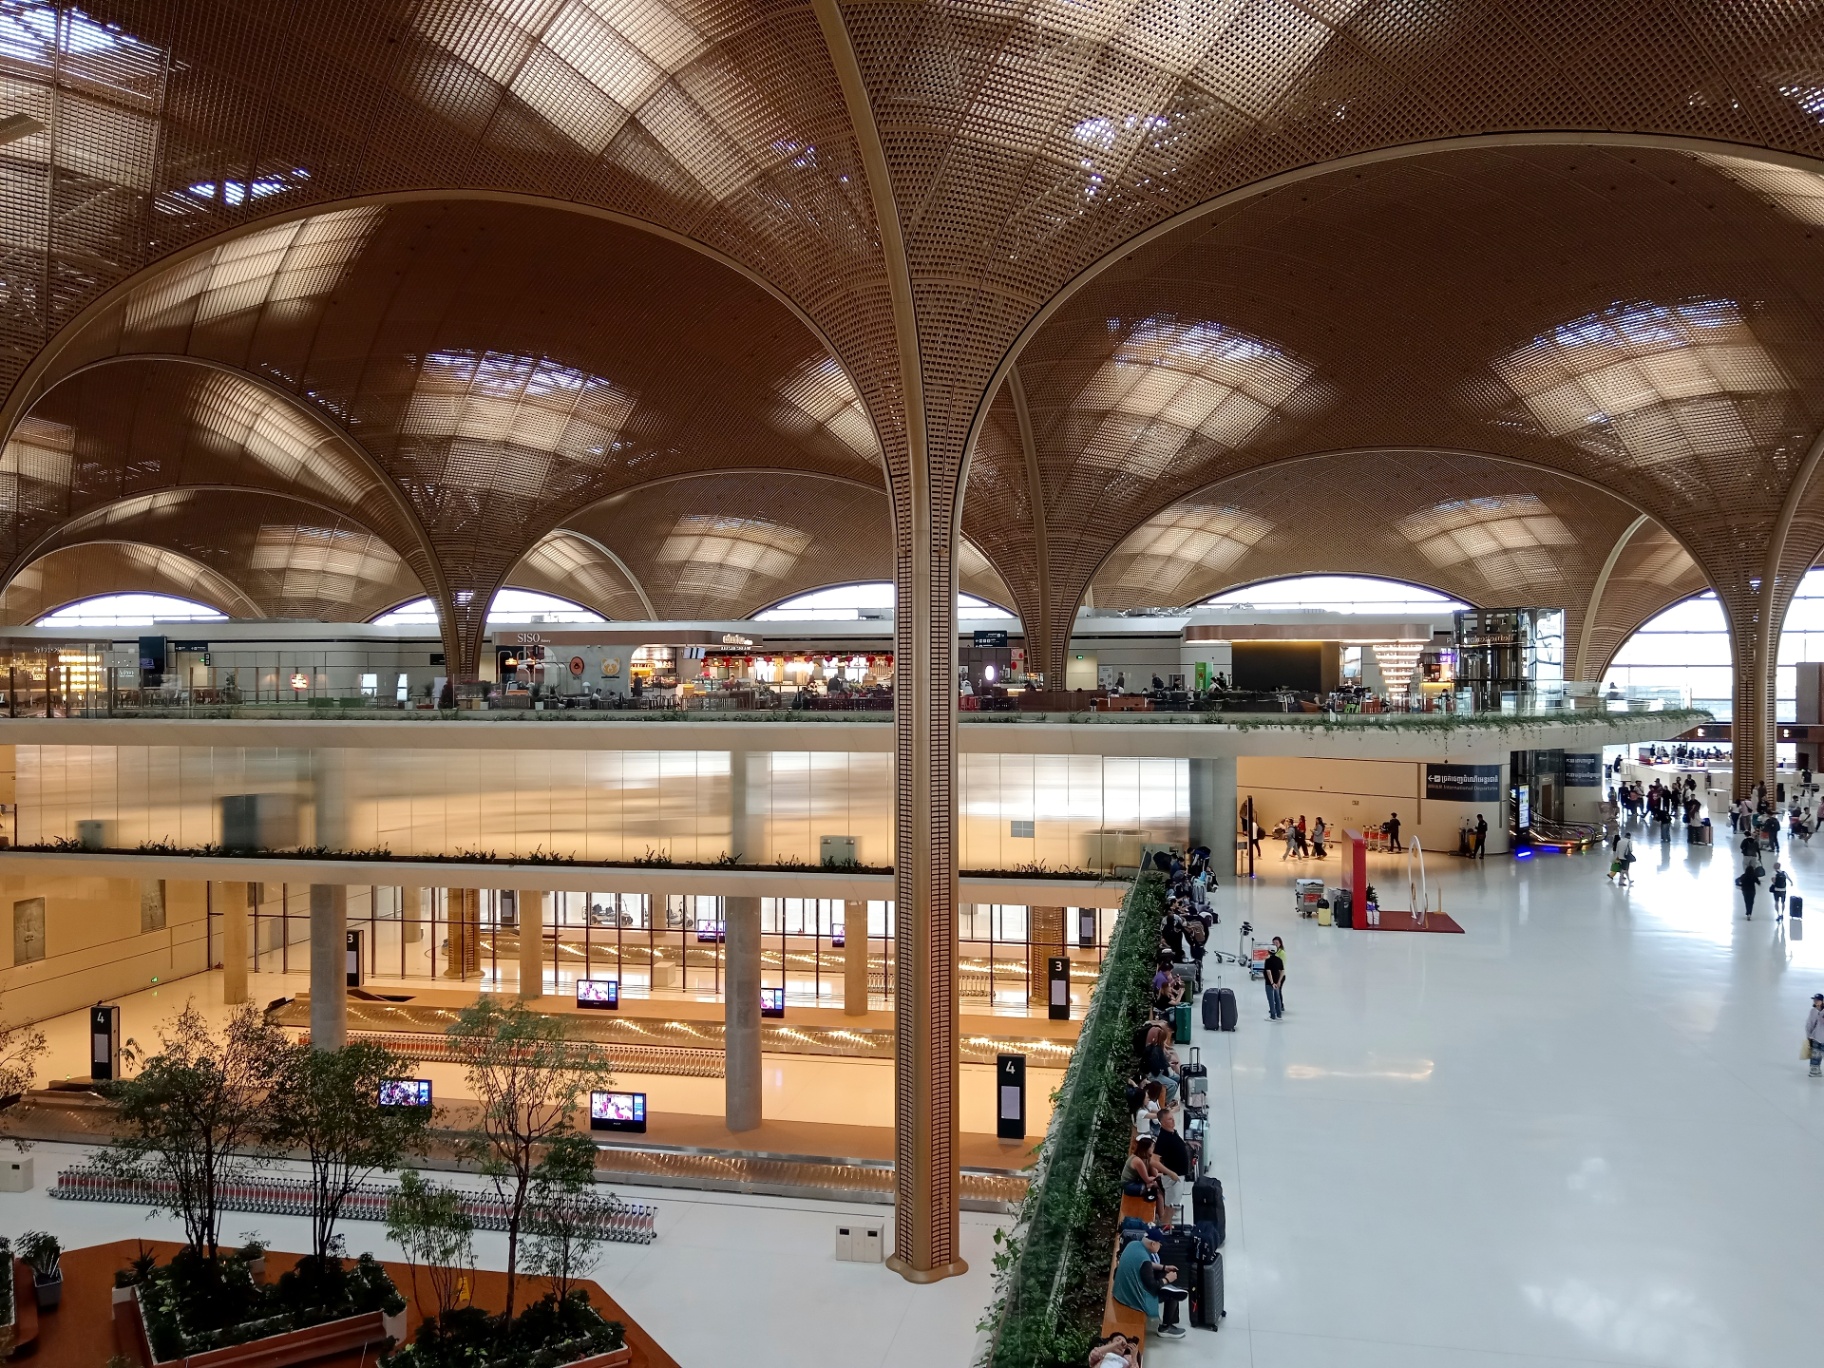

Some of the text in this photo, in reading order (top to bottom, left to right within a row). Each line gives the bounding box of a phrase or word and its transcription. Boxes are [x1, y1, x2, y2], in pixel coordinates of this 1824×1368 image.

[517, 633, 540, 643] SISO
[347, 933, 354, 943] 3
[1055, 961, 1062, 971] 3
[97, 1011, 104, 1024] 4
[1005, 1060, 1015, 1074] 4
